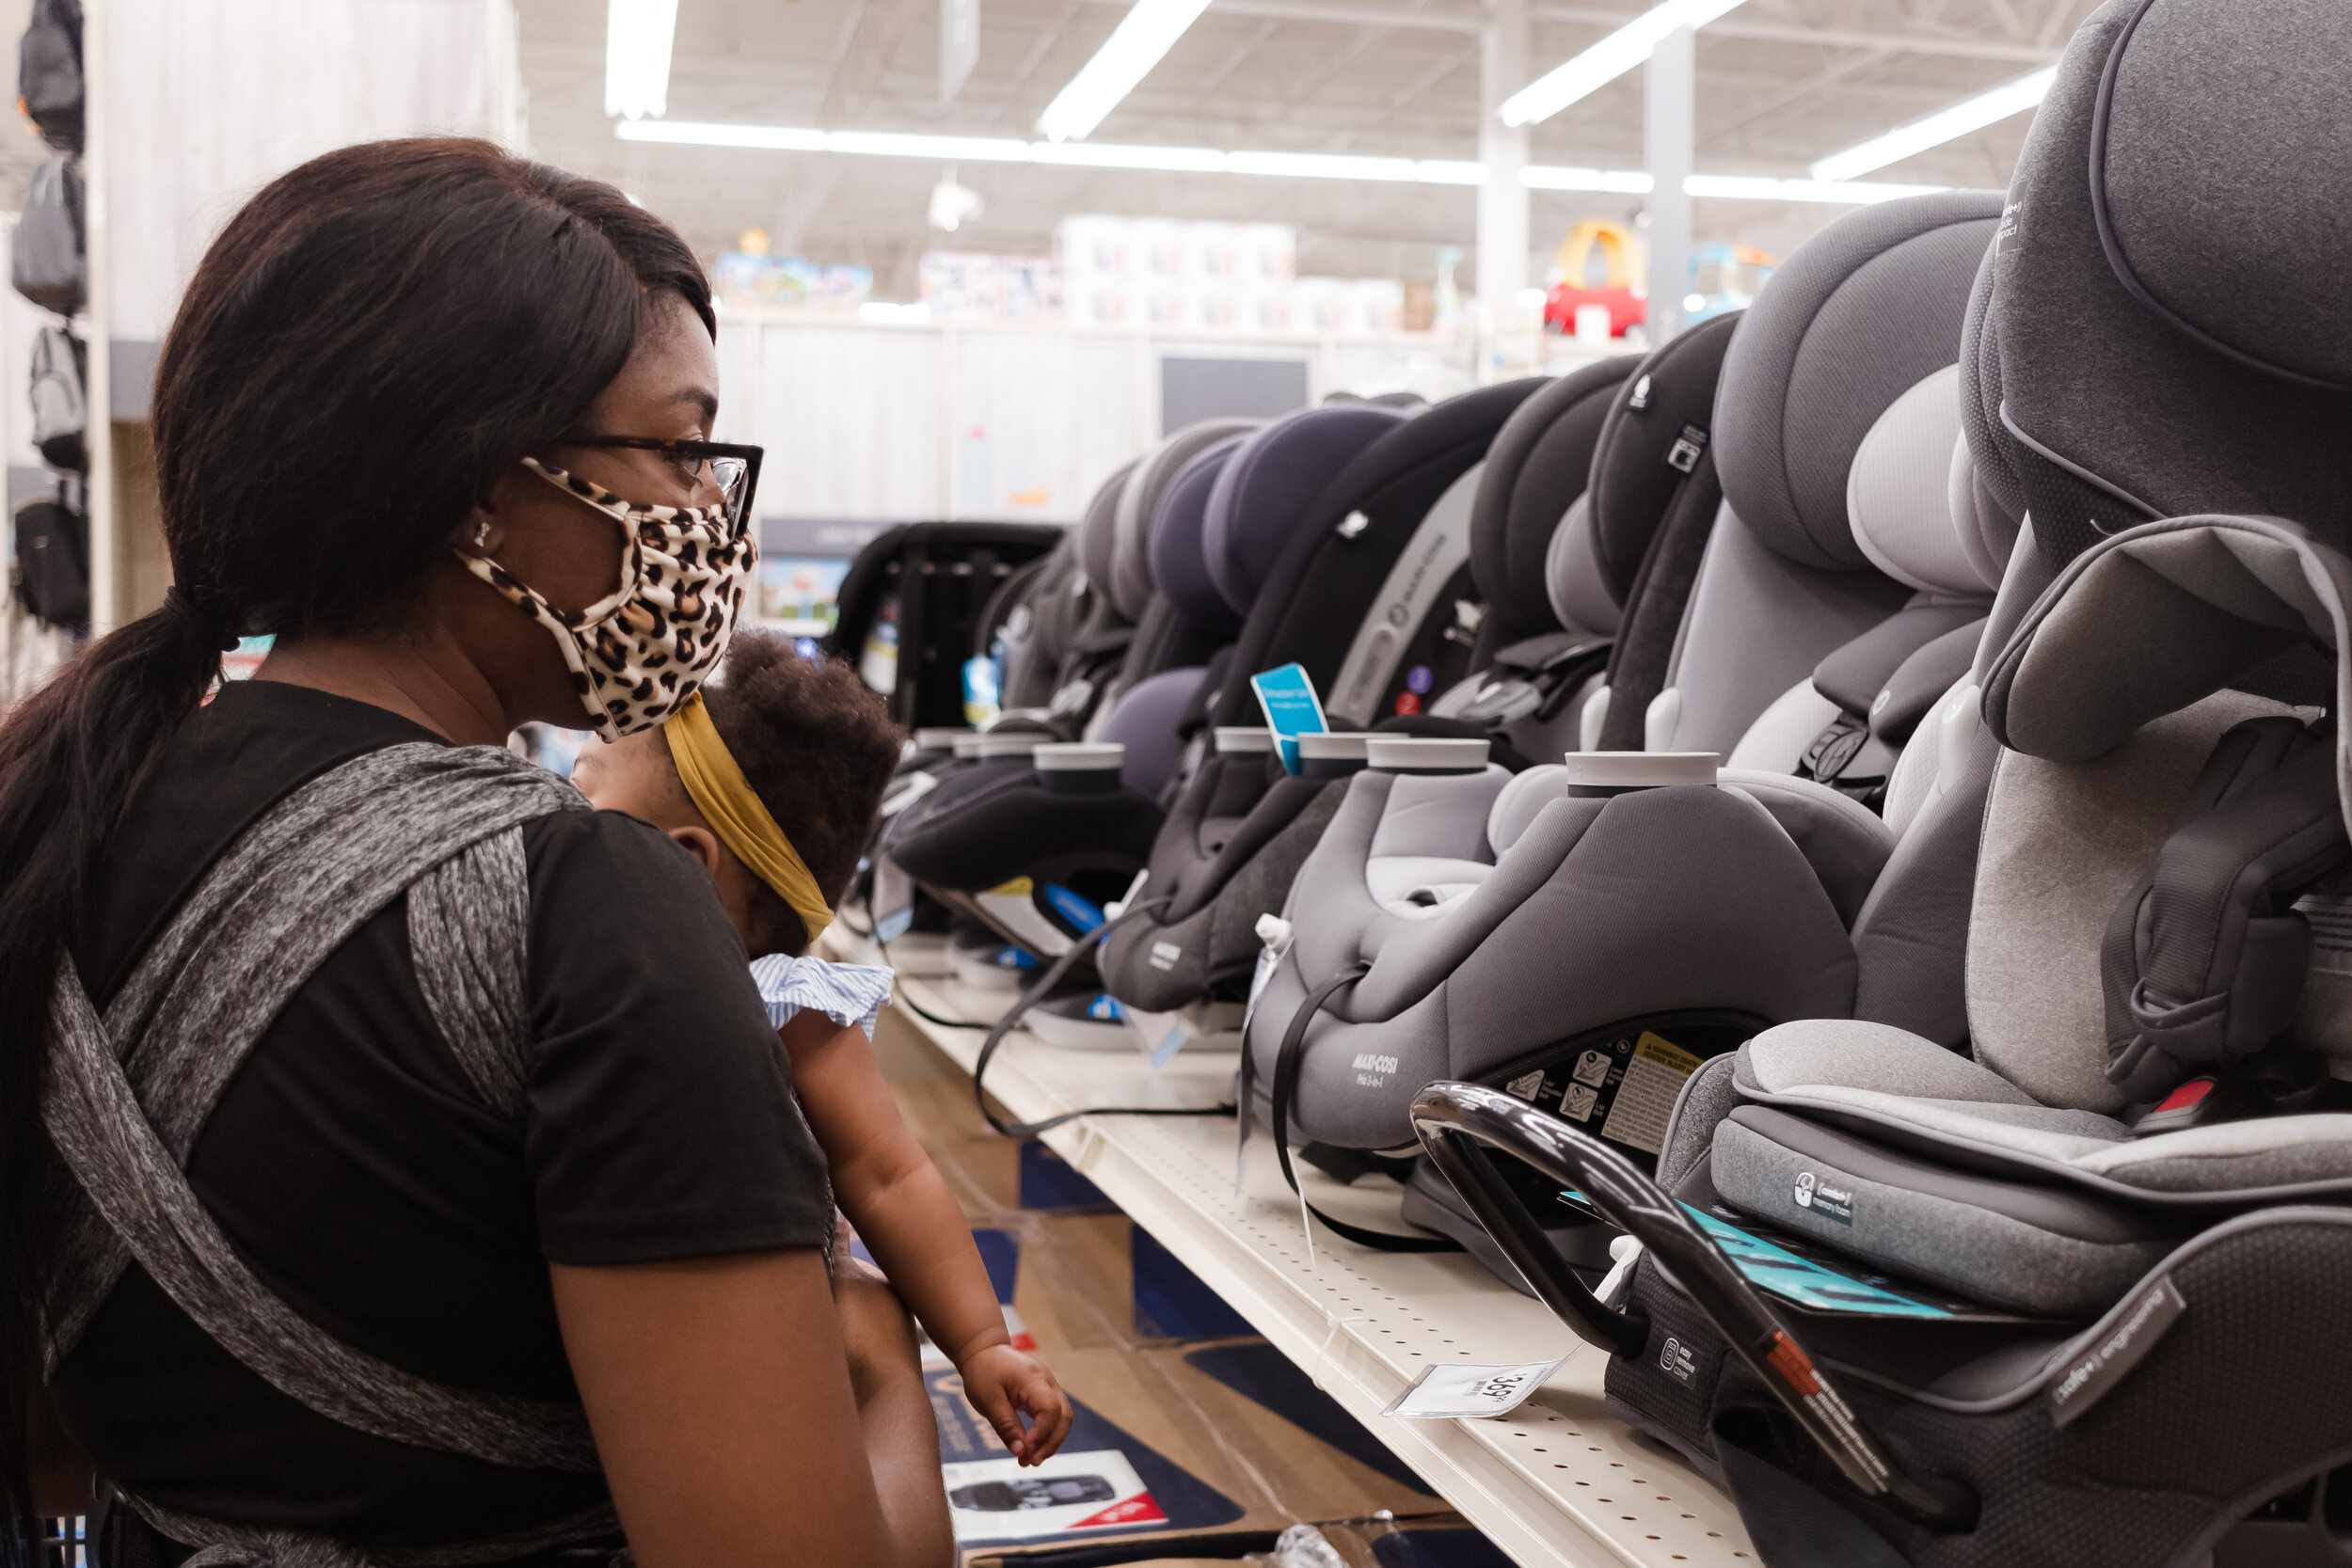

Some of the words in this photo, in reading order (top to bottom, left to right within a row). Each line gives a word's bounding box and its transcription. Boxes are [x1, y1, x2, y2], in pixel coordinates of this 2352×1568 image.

[1679, 1346, 1692, 1361] easy
[1677, 1355, 1695, 1373] remove
[1674, 1366, 1689, 1380] cover
